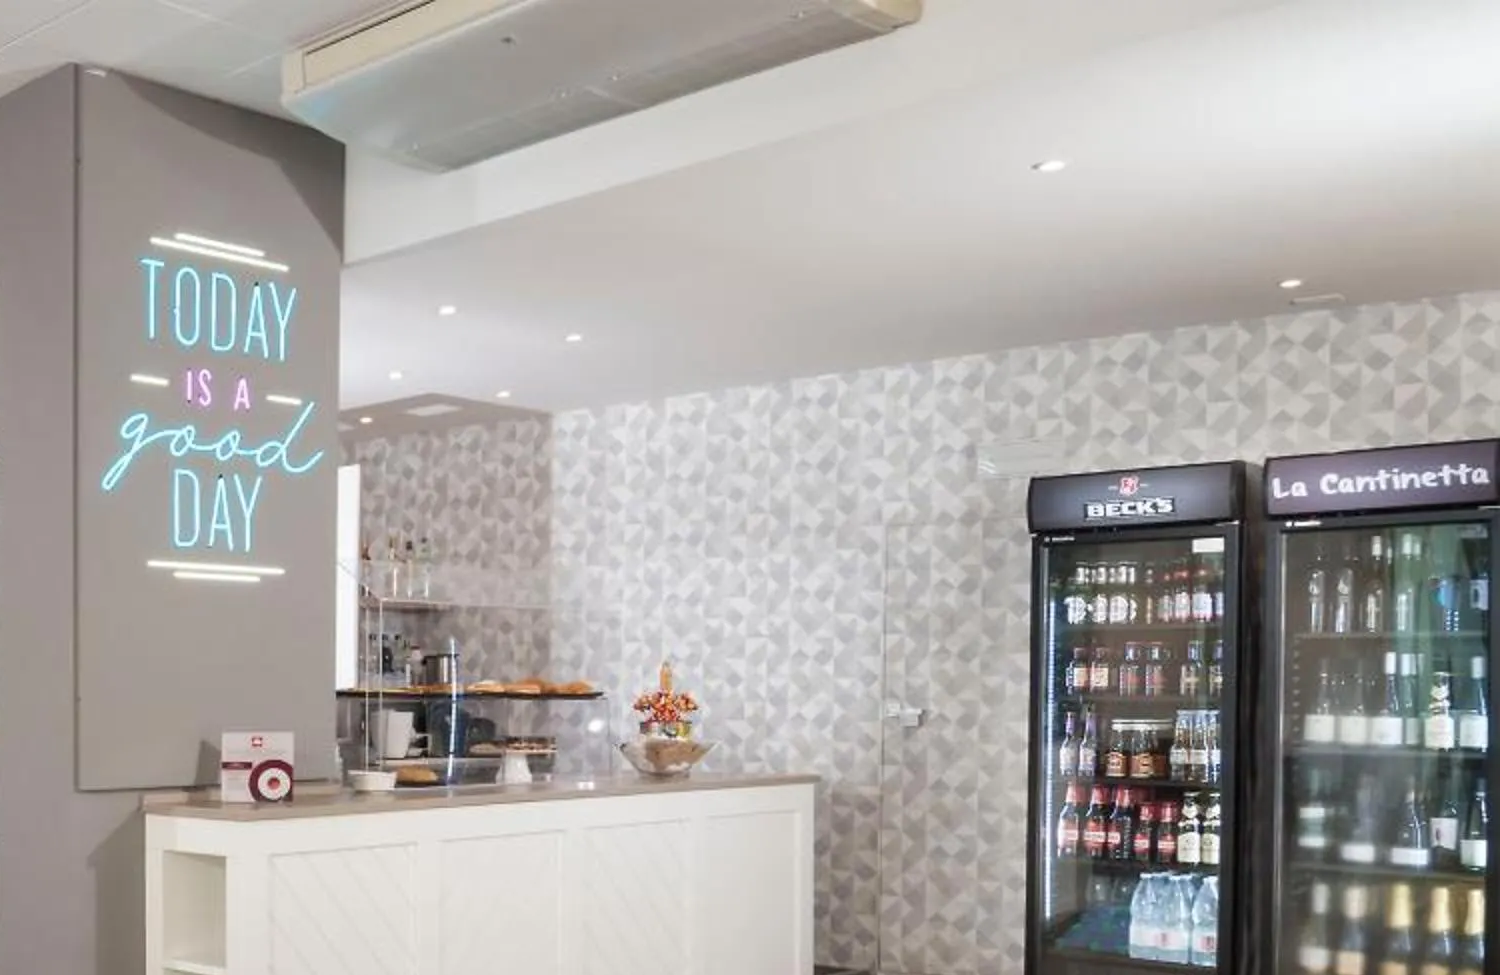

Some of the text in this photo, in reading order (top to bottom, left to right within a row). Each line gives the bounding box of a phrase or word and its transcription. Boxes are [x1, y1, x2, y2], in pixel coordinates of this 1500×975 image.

[140, 258, 297, 361] TODAY
[186, 368, 251, 411] IS A
[101, 402, 325, 491] good
[1271, 463, 1491, 499] La Cantinetta
[173, 468, 262, 552] DAY
